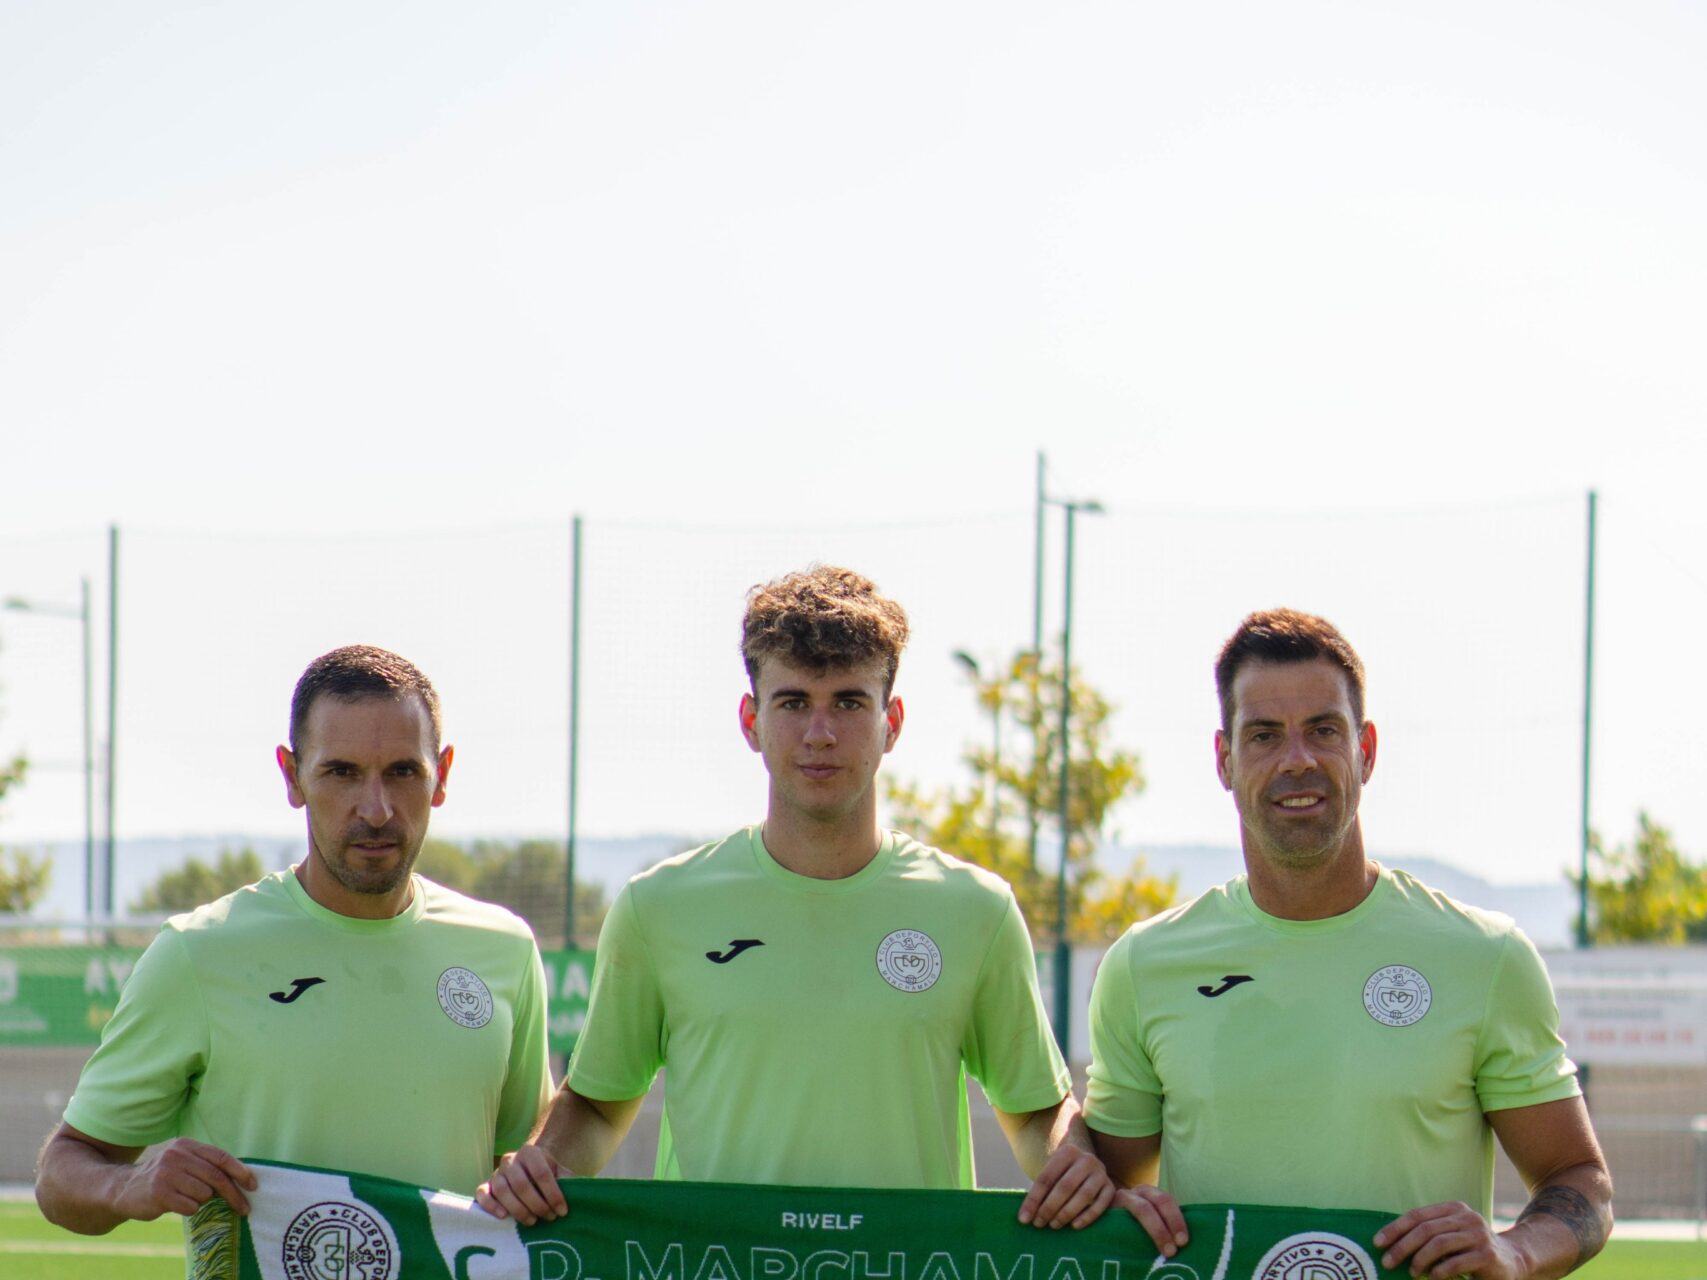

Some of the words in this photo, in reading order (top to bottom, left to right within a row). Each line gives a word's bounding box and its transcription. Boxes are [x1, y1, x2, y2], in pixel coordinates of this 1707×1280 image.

[896, 932, 938, 958] DEPORTIVO
[882, 971, 936, 990] MARCHAMALO
[1386, 968, 1428, 994] DEPORTIVO
[1368, 1004, 1423, 1024] MARCHAMALO
[341, 1208, 378, 1237] CLUB
[782, 1212, 863, 1230] RIVELF
